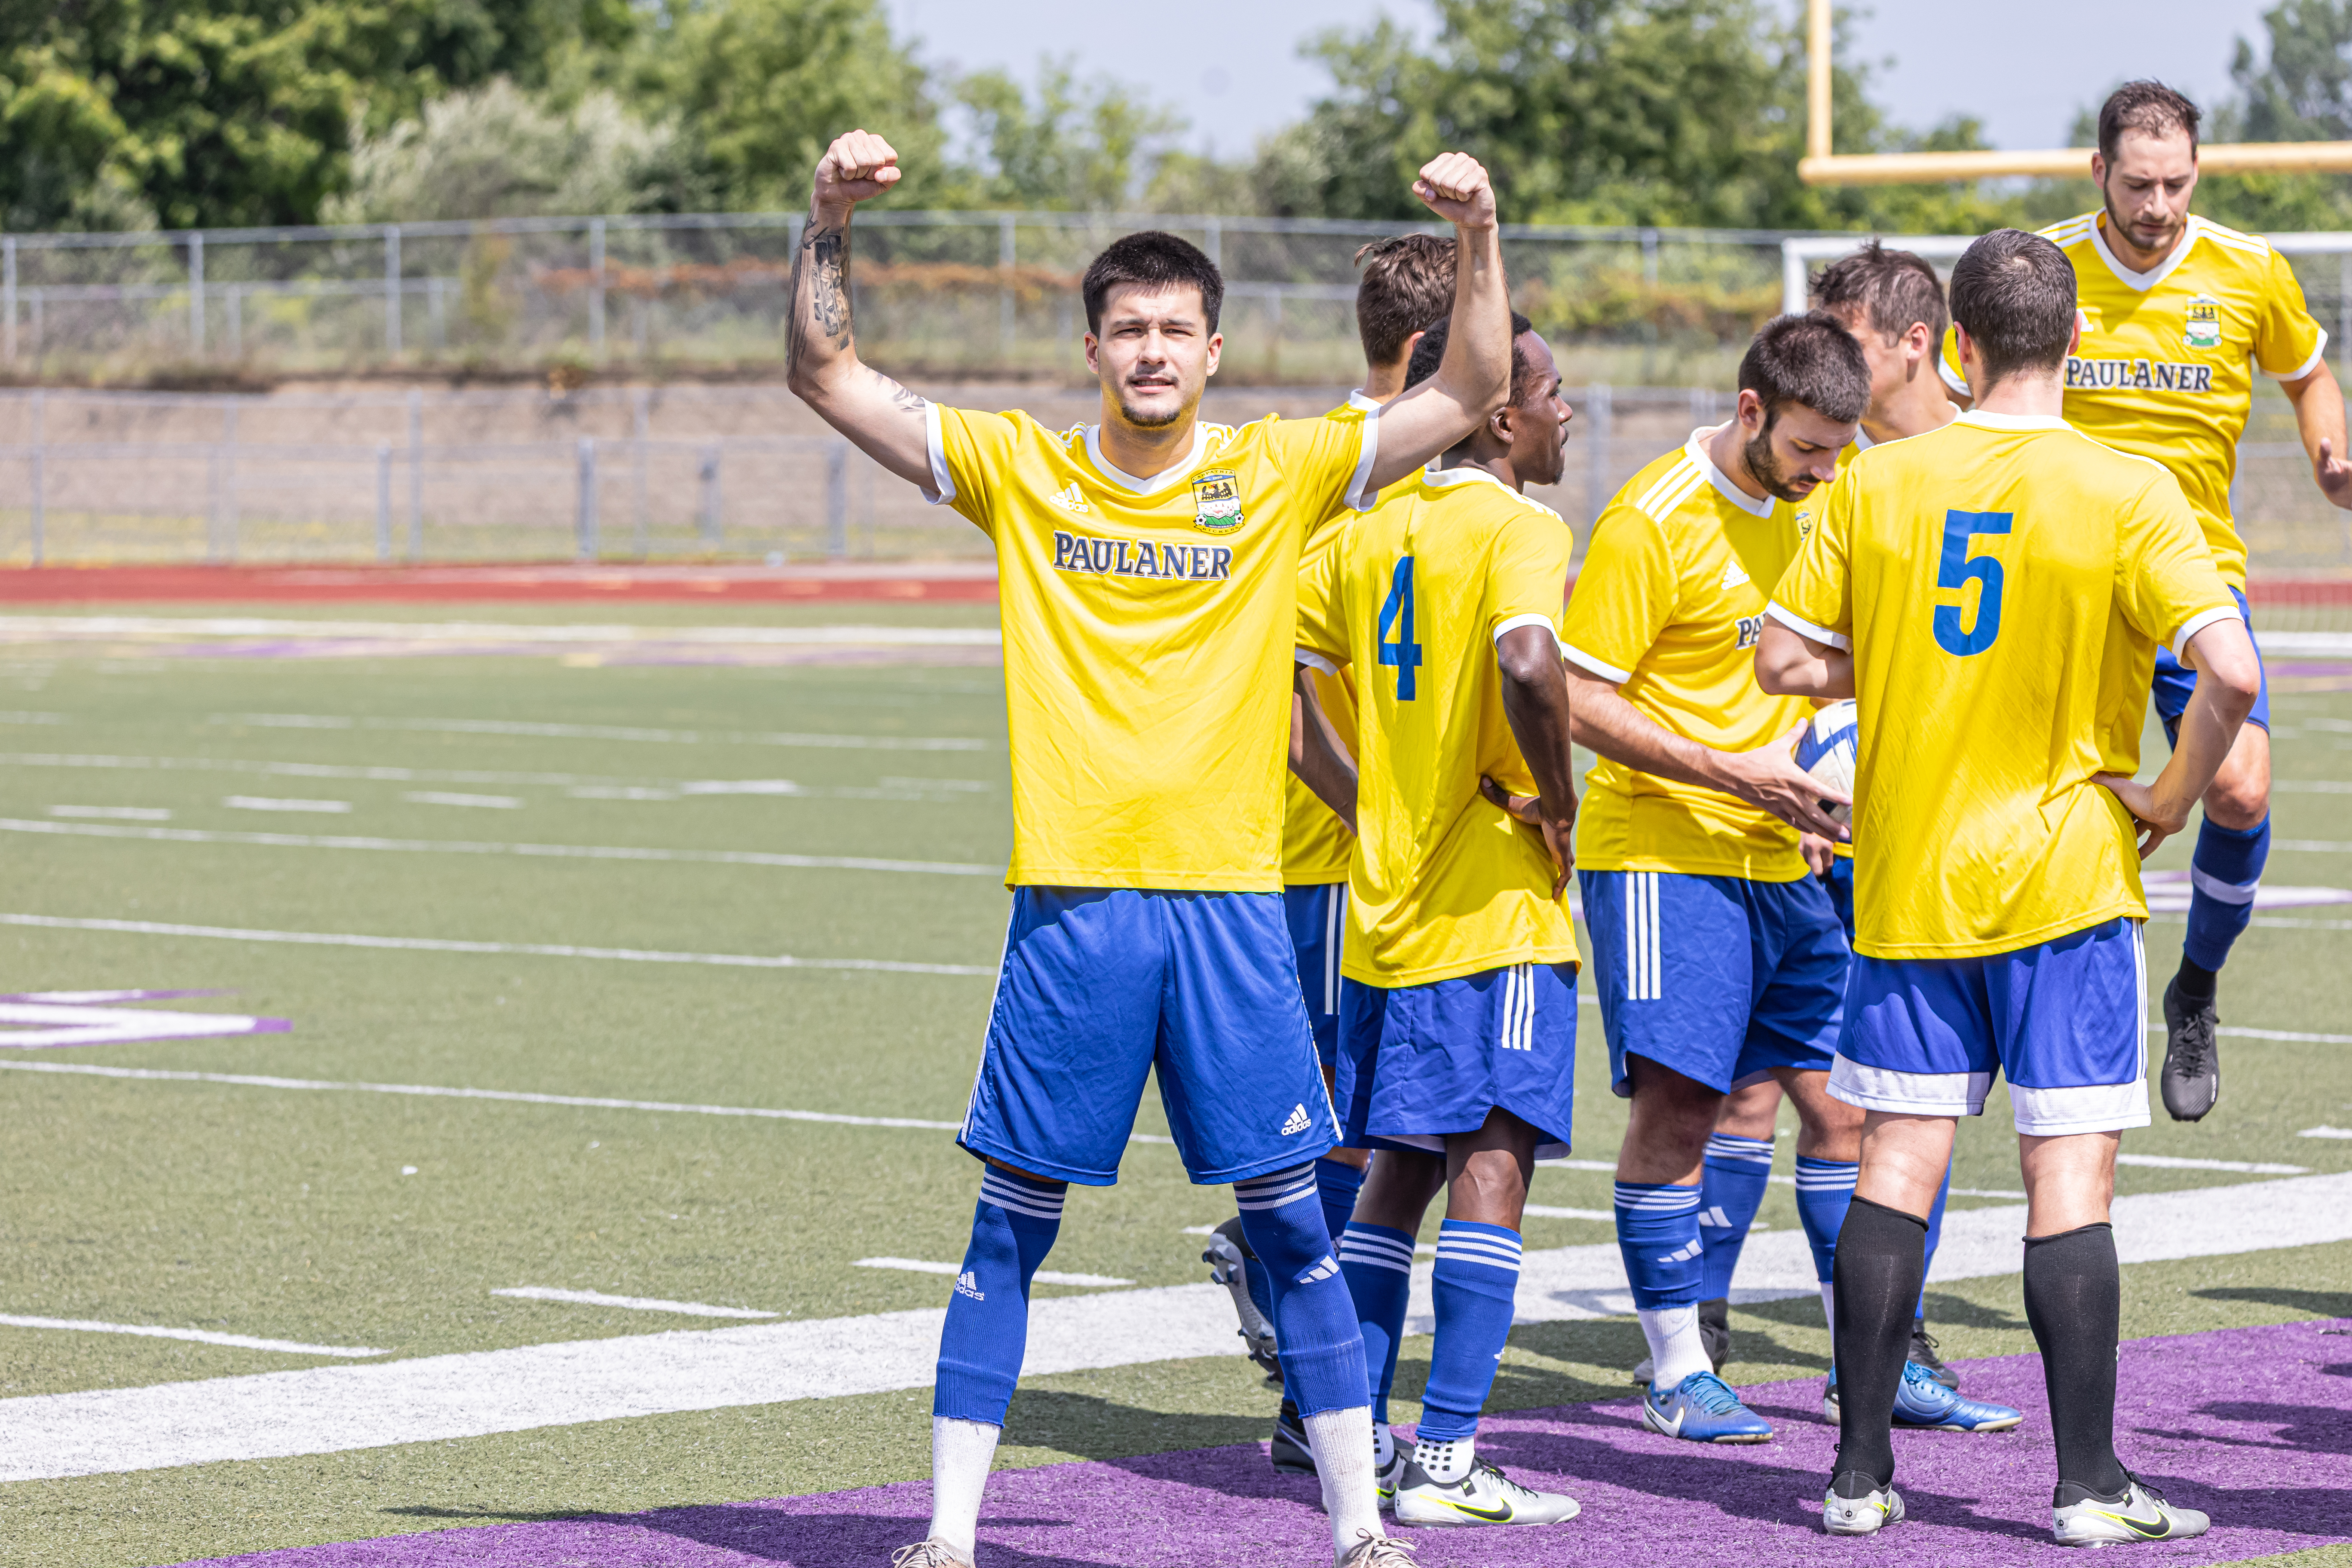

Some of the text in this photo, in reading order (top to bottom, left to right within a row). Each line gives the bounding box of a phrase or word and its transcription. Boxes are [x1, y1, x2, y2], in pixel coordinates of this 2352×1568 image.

[2066, 358, 2212, 392] PAULANER
[1193, 470, 1234, 481] CARPATHIA
[1049, 496, 1089, 513] adidas
[1054, 531, 1233, 580] PAULANER
[1932, 509, 2014, 657] 5
[1378, 556, 1422, 701] 4
[1281, 1118, 1311, 1136] adidas
